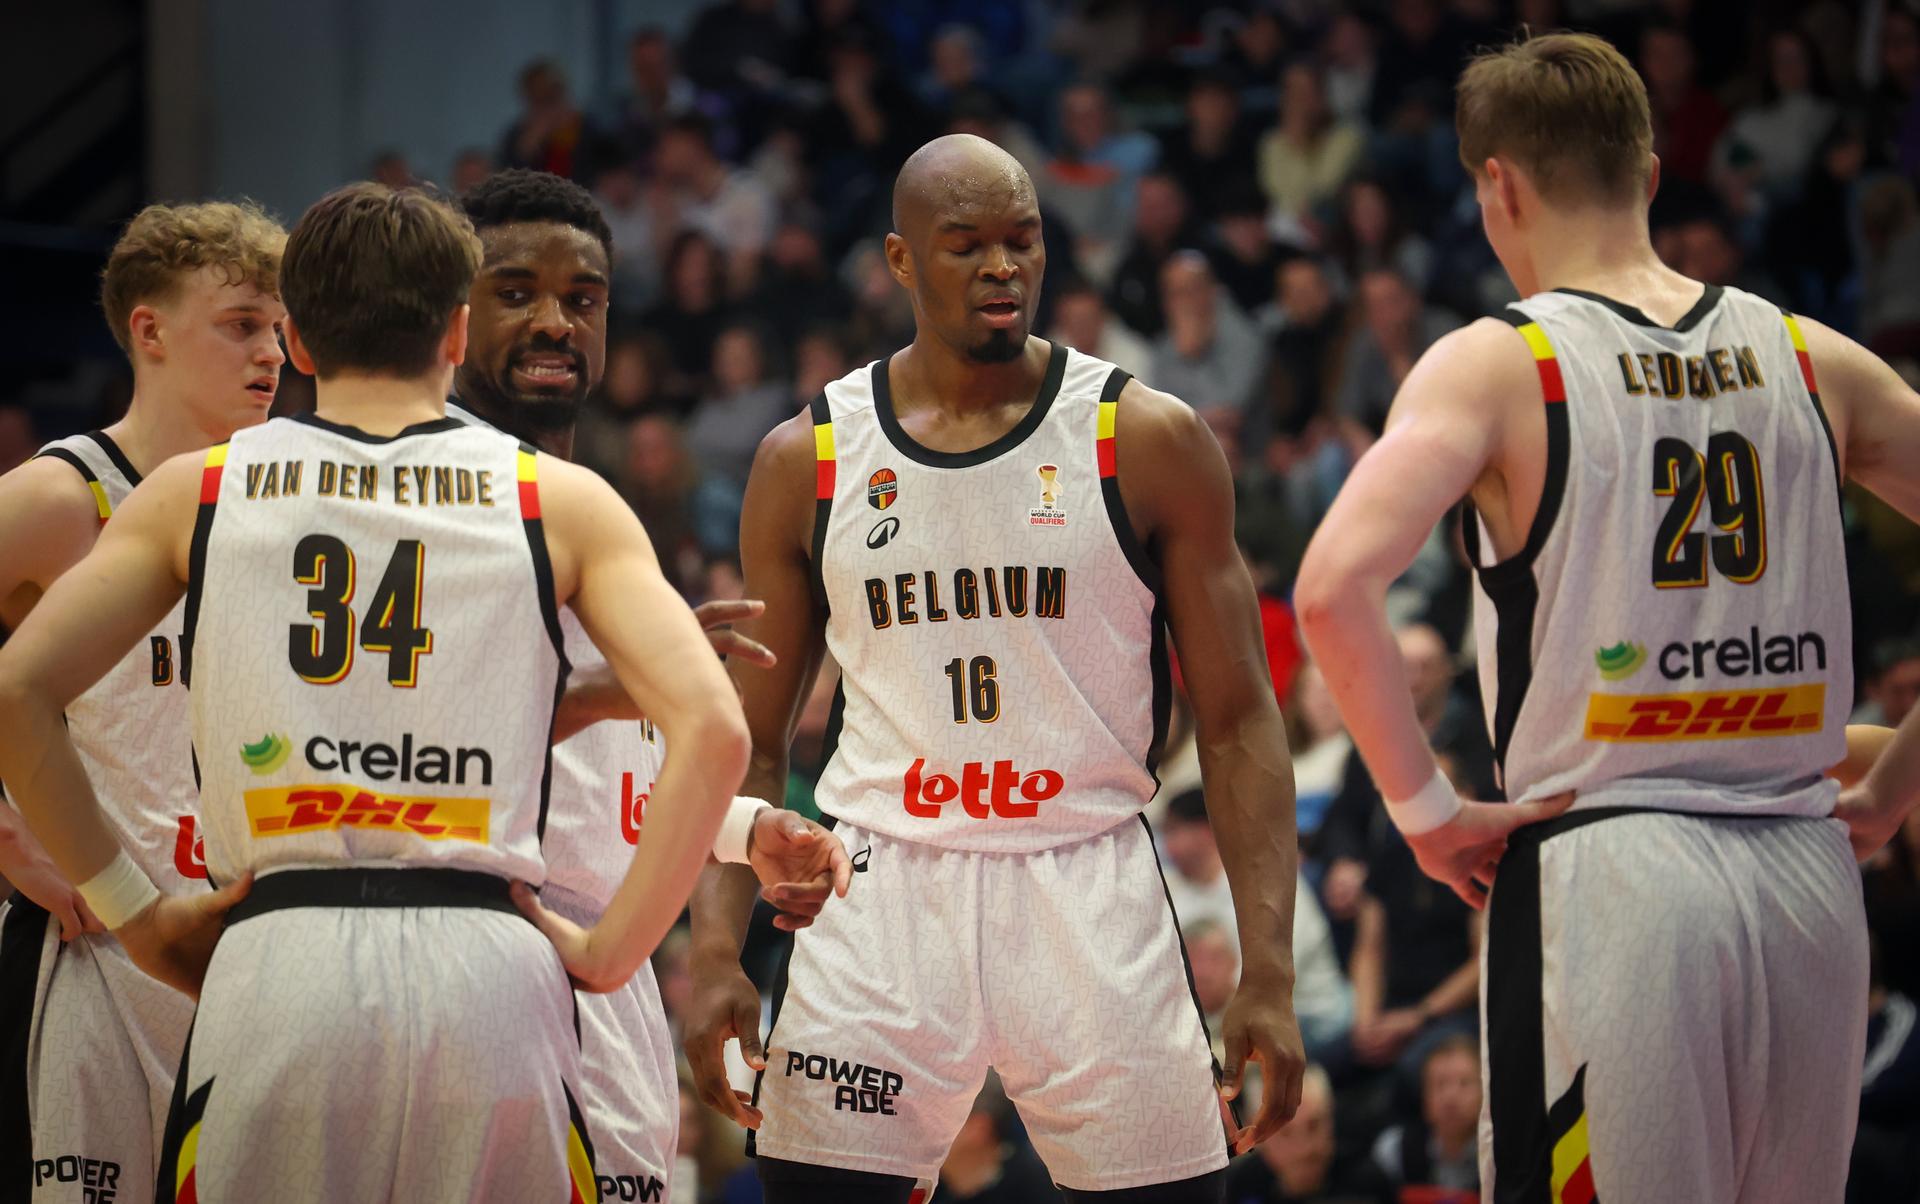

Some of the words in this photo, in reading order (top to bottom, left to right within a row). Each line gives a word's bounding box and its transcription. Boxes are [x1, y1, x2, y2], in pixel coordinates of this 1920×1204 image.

[246, 460, 303, 500] VAN
[318, 459, 379, 501] DEN
[394, 465, 495, 507] EYNDE
[1652, 430, 1768, 589] 29
[1030, 517, 1066, 525] QUALIFIERS
[288, 533, 434, 688] 34
[864, 566, 1067, 630] BELGIUM
[1659, 626, 1826, 681] crelan
[944, 655, 1001, 724] 16
[1623, 693, 1796, 737] DHL
[304, 733, 493, 786] crelan
[286, 790, 448, 835] DHL
[903, 758, 1064, 819] Lotto
[785, 1051, 904, 1096] POWER
